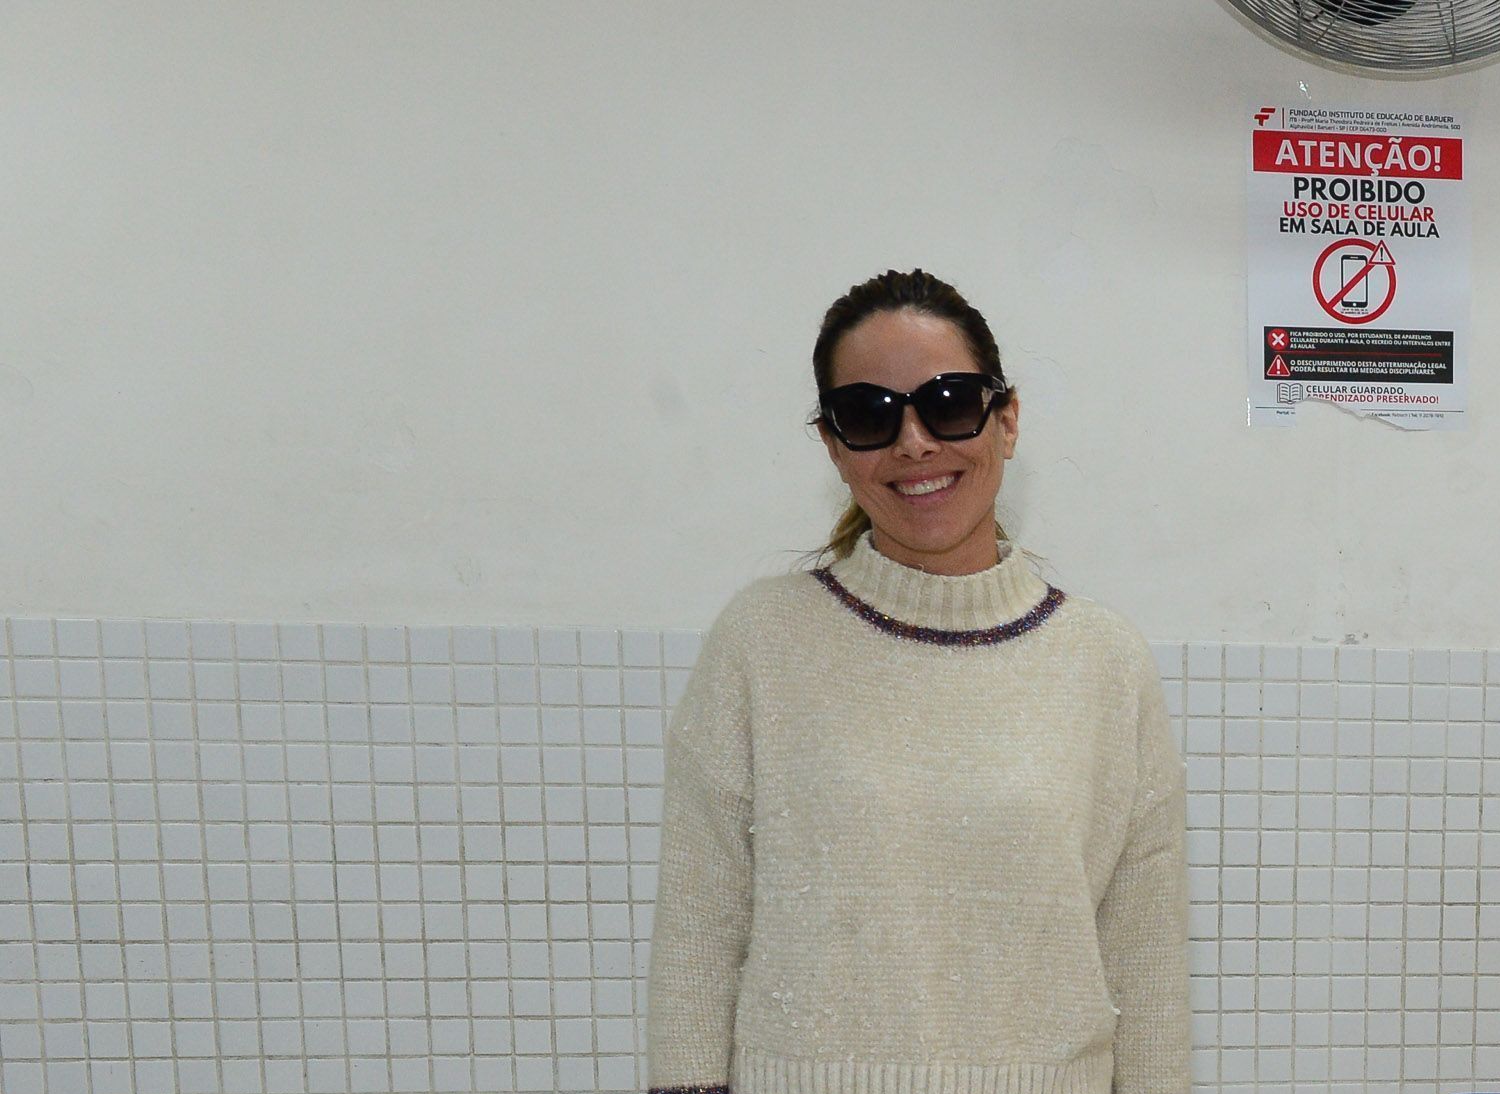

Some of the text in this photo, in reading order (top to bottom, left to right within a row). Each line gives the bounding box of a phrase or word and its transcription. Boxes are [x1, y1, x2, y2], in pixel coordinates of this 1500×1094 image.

[1289, 109, 1328, 118] FUNDAÇÃO
[1329, 111, 1364, 119] INSTITUTO
[1376, 112, 1413, 122] EDUCAÇÃO
[1425, 115, 1454, 123] BARUERI
[1275, 136, 1441, 177] ATENÇÃO!
[1293, 176, 1426, 205] PROIBIDO
[1283, 201, 1435, 223] USO DE CELULAR
[1279, 218, 1440, 239] EM SALA DE AULA
[1378, 361, 1427, 370] DETERMINAÇÃO
[1306, 385, 1407, 396] CELULAR GUARDADO,
[1376, 395, 1439, 404] PRESERVADO!
